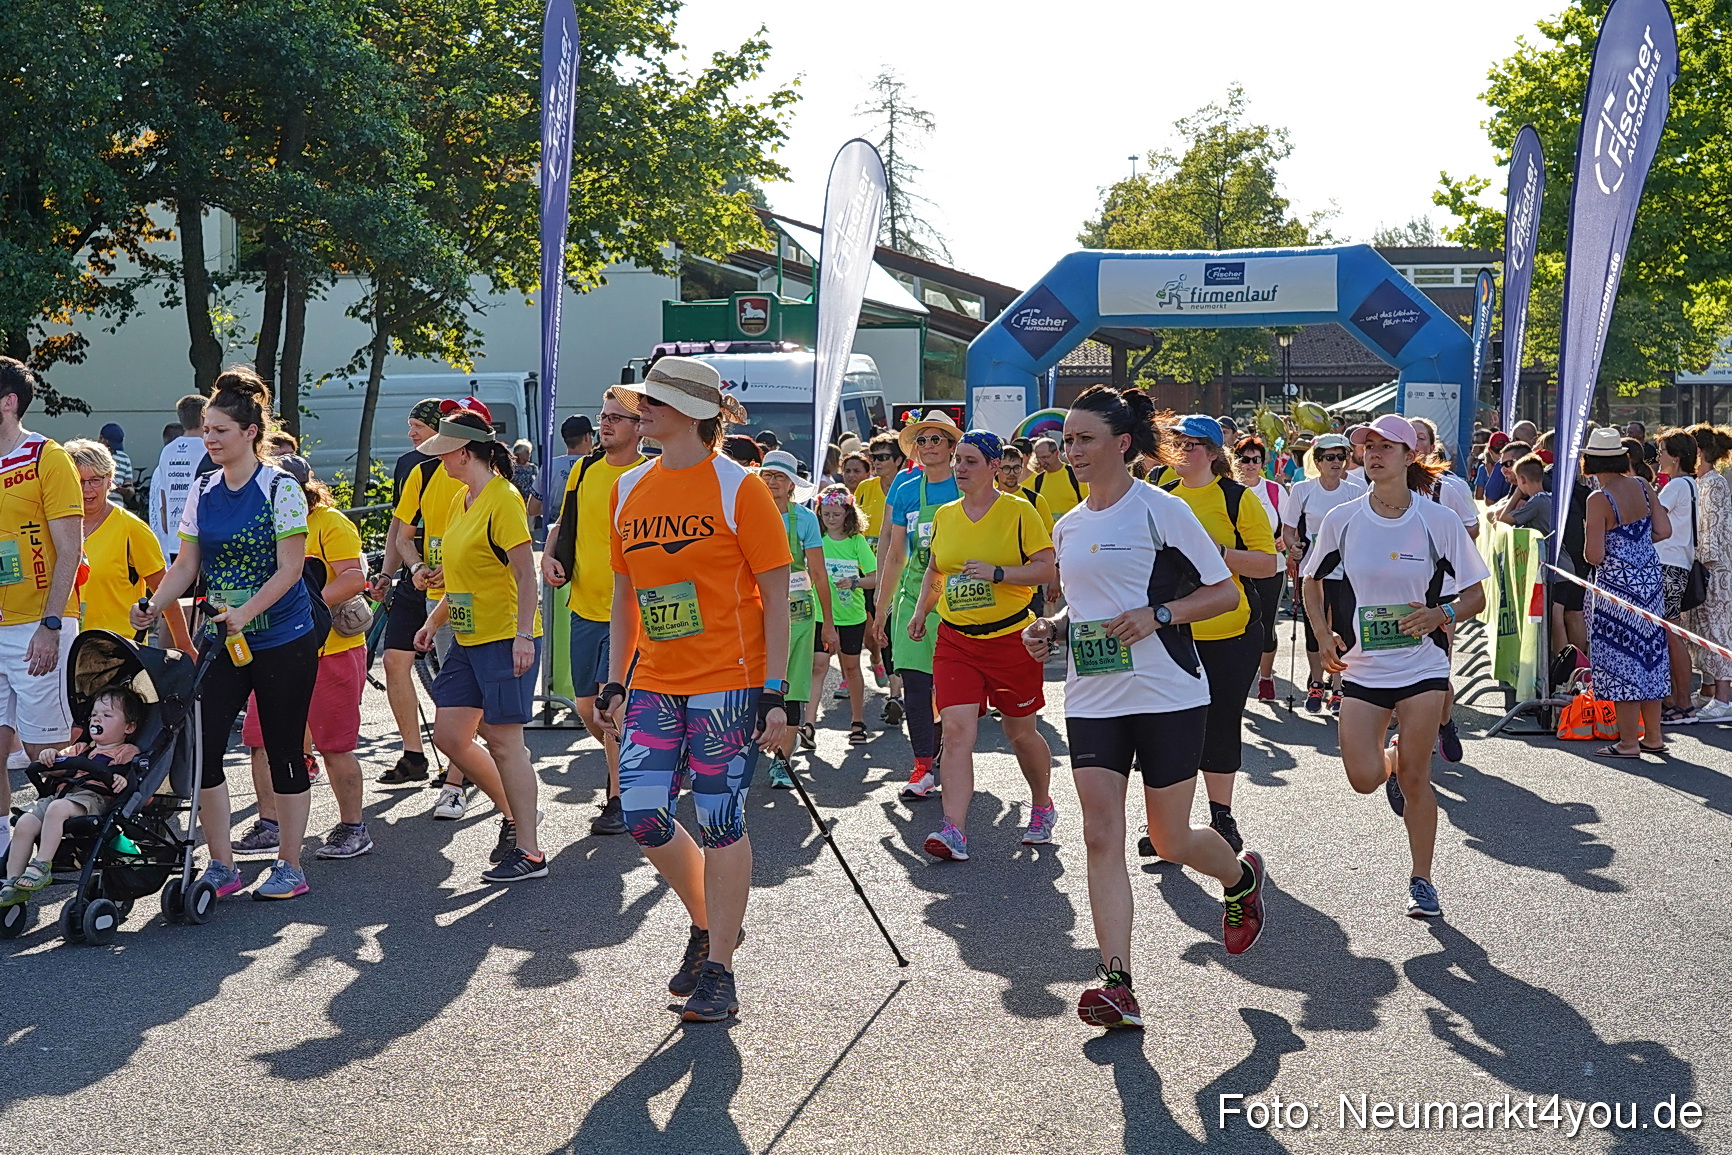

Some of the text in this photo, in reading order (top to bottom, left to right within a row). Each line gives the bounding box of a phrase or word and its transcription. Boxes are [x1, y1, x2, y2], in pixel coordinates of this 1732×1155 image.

[1607, 25, 1655, 169] Fischer
[1627, 48, 1662, 163] AUTOMOBILE
[1516, 153, 1535, 253] Fischer
[840, 166, 870, 261] Fischer
[1212, 271, 1243, 279] Fischer
[1190, 285, 1279, 303] firmenlauf
[1020, 316, 1068, 326] Fischer
[1366, 313, 1379, 321] und
[1380, 311, 1392, 319] das
[548, 237, 565, 436] www.fischer-automobile.de
[633, 515, 714, 540] WINGS
[12, 557, 20, 577] 2022
[953, 583, 985, 598] 1256
[650, 603, 680, 623] 577
[688, 602, 699, 627] 2022
[666, 621, 689, 630] Carolin
[1371, 620, 1400, 635] 131
[1078, 637, 1118, 658] 1319
